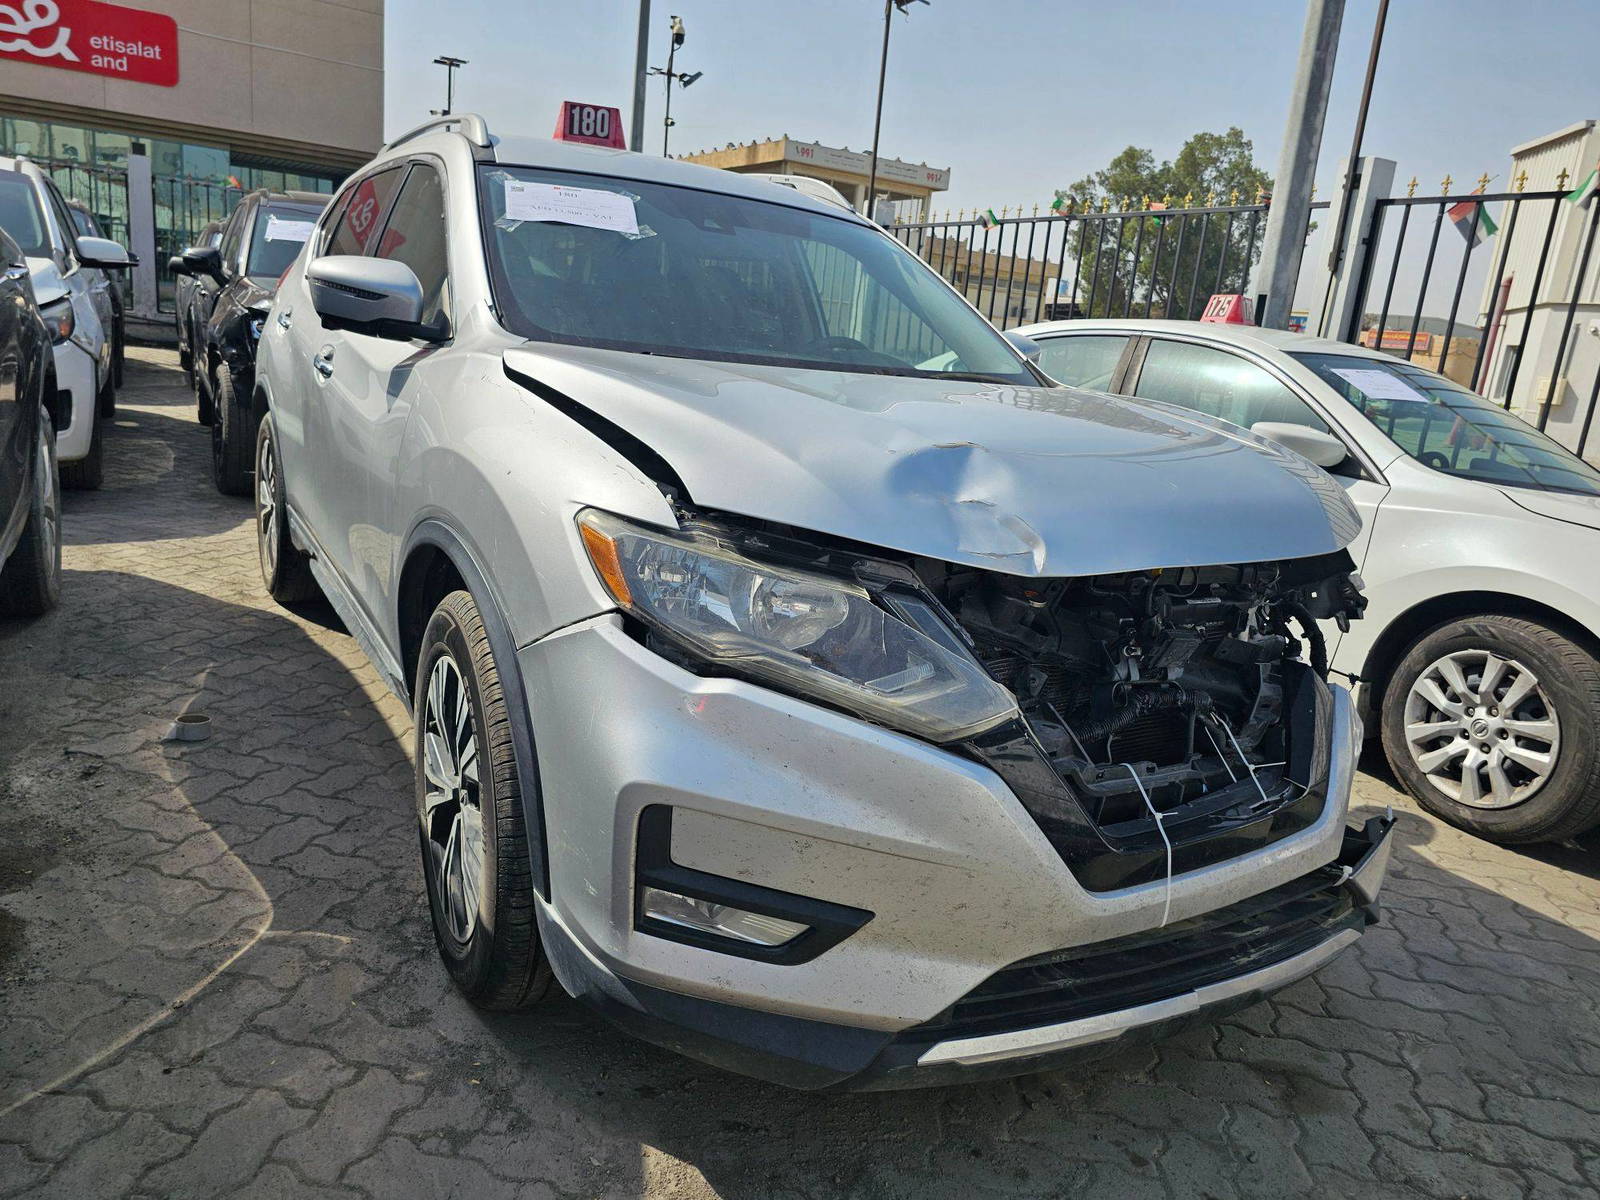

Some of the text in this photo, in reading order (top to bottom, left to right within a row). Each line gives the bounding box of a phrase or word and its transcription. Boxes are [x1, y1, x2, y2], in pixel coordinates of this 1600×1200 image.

[89, 35, 162, 60] etisalat
[90, 54, 128, 72] and
[572, 106, 610, 138] 180
[1206, 296, 1233, 317] 175
